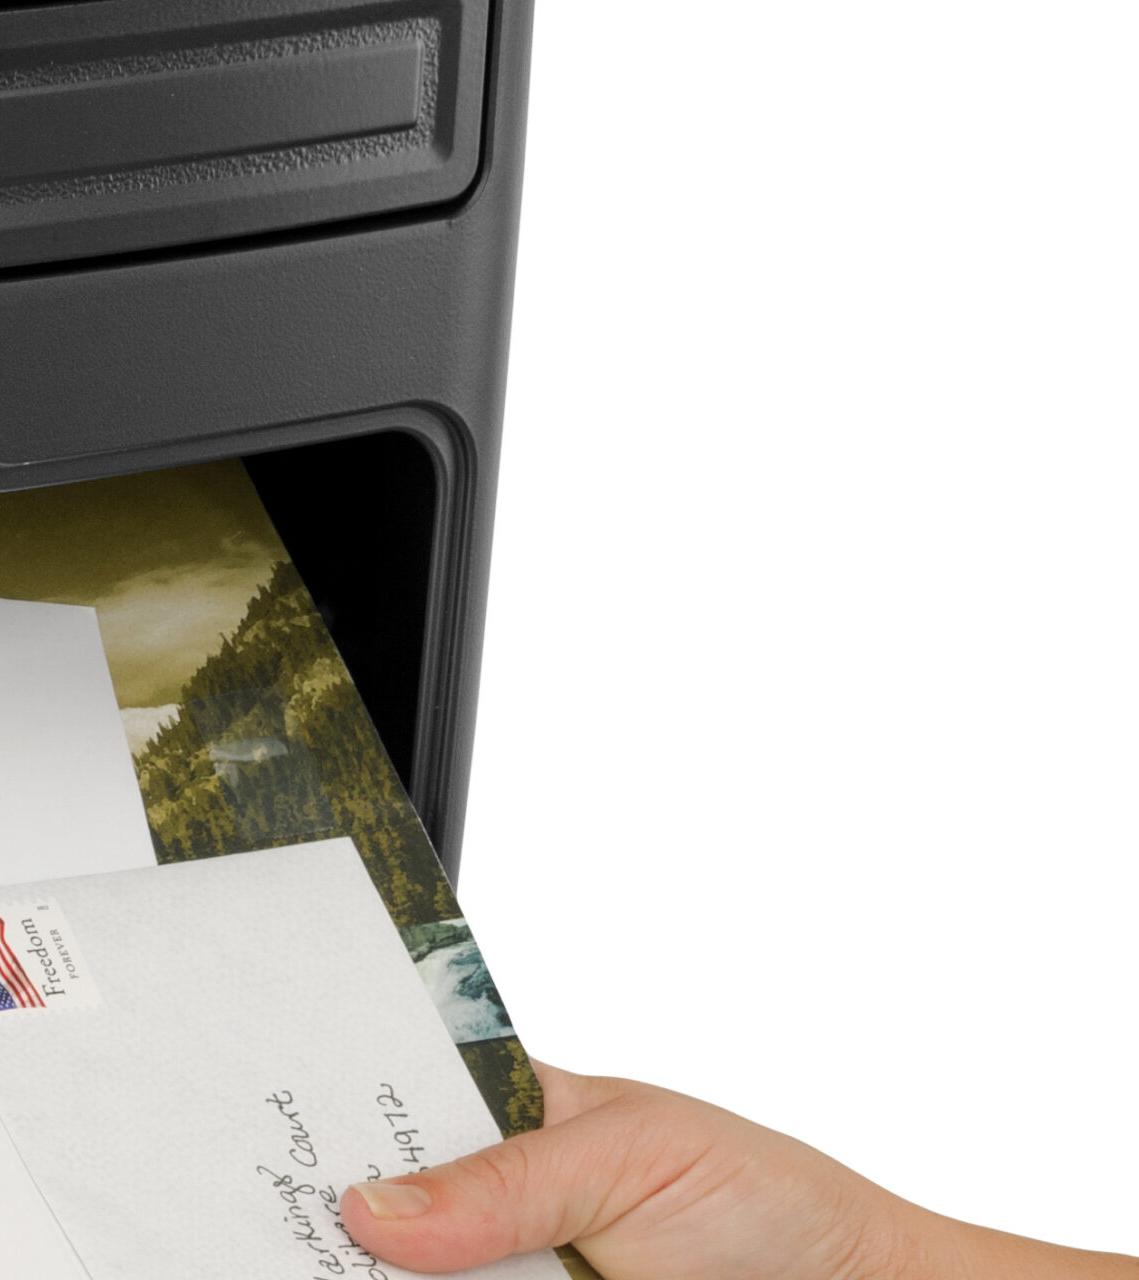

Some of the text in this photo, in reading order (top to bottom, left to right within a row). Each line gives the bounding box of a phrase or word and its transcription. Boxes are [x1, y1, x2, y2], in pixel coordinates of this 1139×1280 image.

[21, 918, 66, 997] Freedom
[50, 929, 79, 979] FOREVER
[265, 1090, 317, 1168] Court
[376, 1083, 428, 1175] 4972
